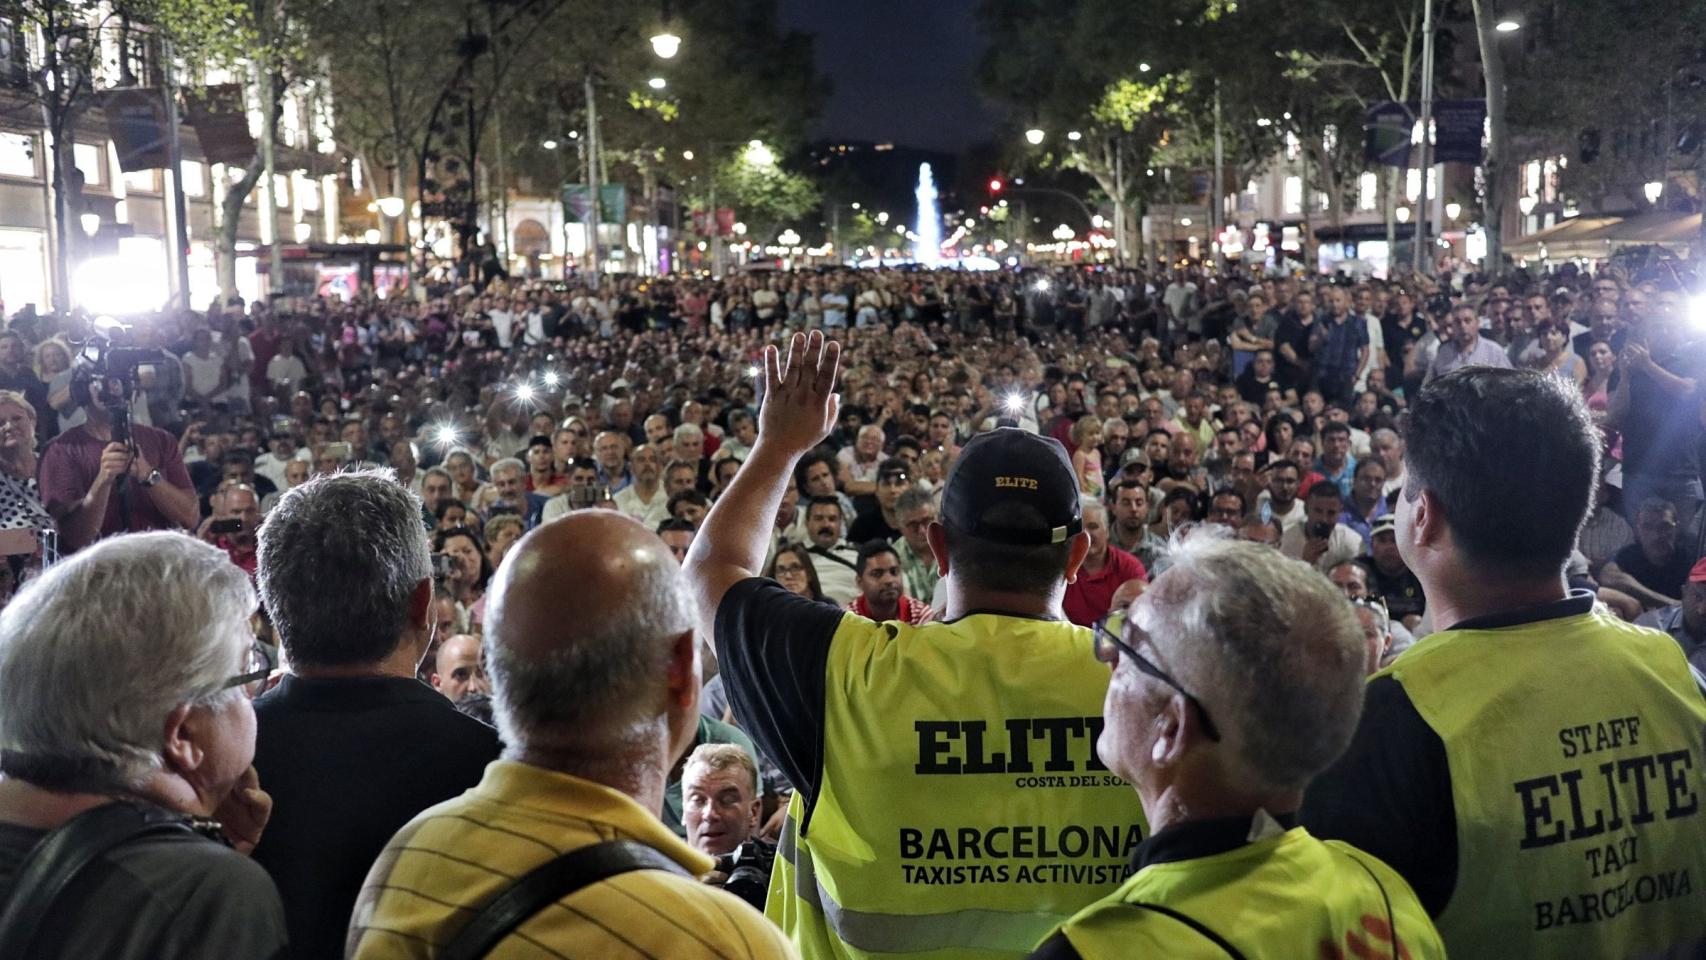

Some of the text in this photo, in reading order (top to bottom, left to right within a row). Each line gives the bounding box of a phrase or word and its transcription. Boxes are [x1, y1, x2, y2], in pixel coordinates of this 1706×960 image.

[995, 476, 1038, 490] ELITE
[1558, 716, 1640, 758] STAFF
[1015, 776, 1066, 788] COSTA
[1069, 775, 1100, 787] DEL
[1513, 749, 1698, 850] ELITE
[899, 824, 1145, 860] BARCELONA
[901, 864, 1010, 885] TAXISTAS
[1534, 868, 1692, 931] BARCELONA
